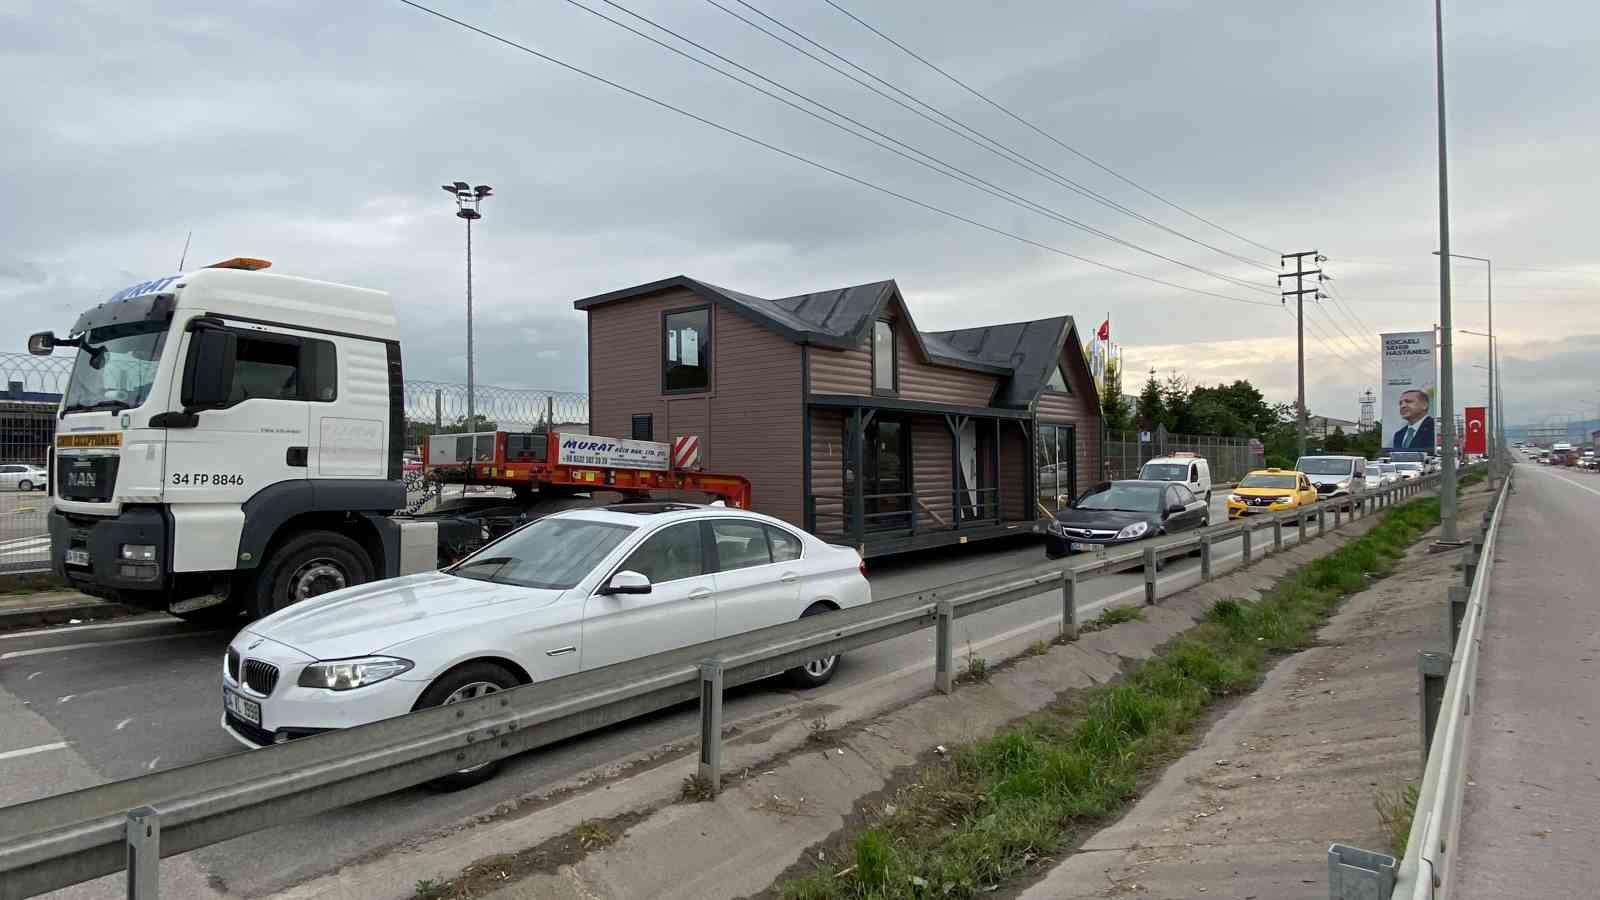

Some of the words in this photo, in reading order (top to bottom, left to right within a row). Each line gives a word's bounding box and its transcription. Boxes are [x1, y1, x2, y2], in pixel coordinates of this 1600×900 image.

[562, 440, 615, 453] MURAT
[67, 472, 97, 488] MAN
[172, 473, 189, 485] 34
[193, 473, 209, 485] FP
[212, 474, 244, 486] 8846
